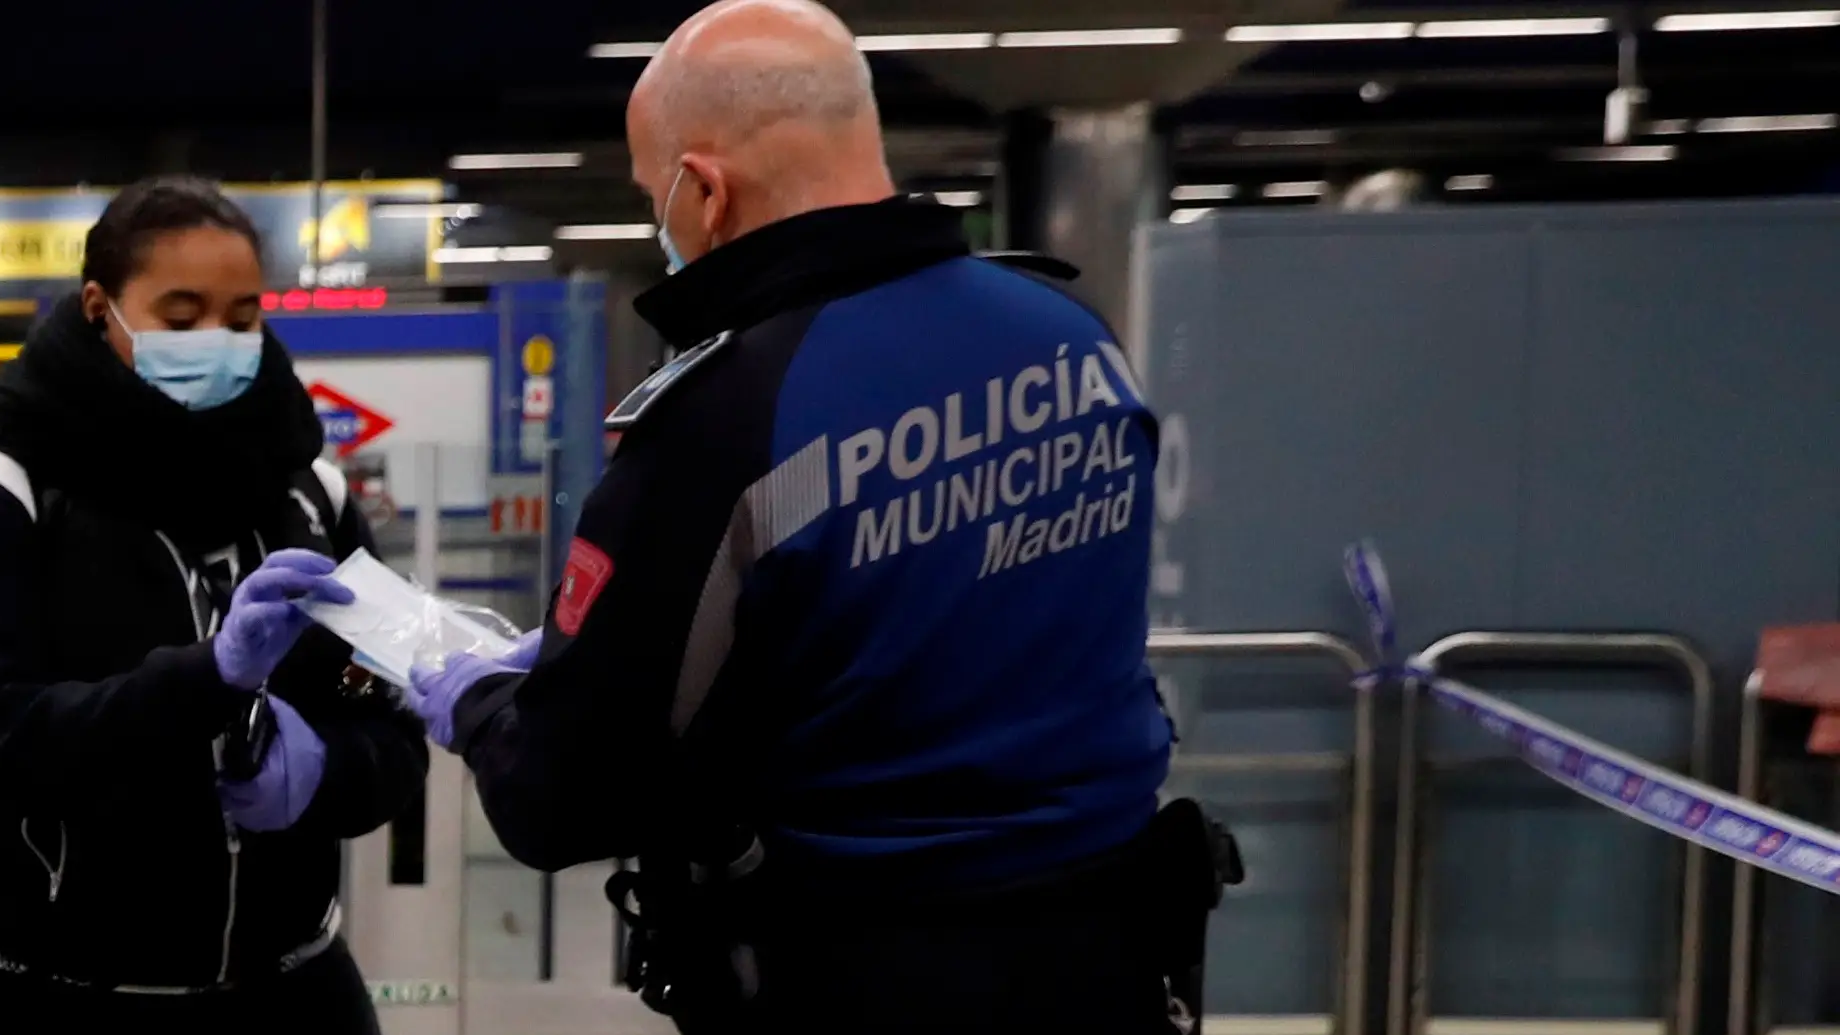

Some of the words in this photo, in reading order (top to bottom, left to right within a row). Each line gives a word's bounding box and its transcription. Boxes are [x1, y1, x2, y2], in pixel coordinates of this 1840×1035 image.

[838, 342, 1120, 507] POLICÍA
[850, 416, 1135, 569] MUNICIPAL
[977, 470, 1136, 581] Madrid
